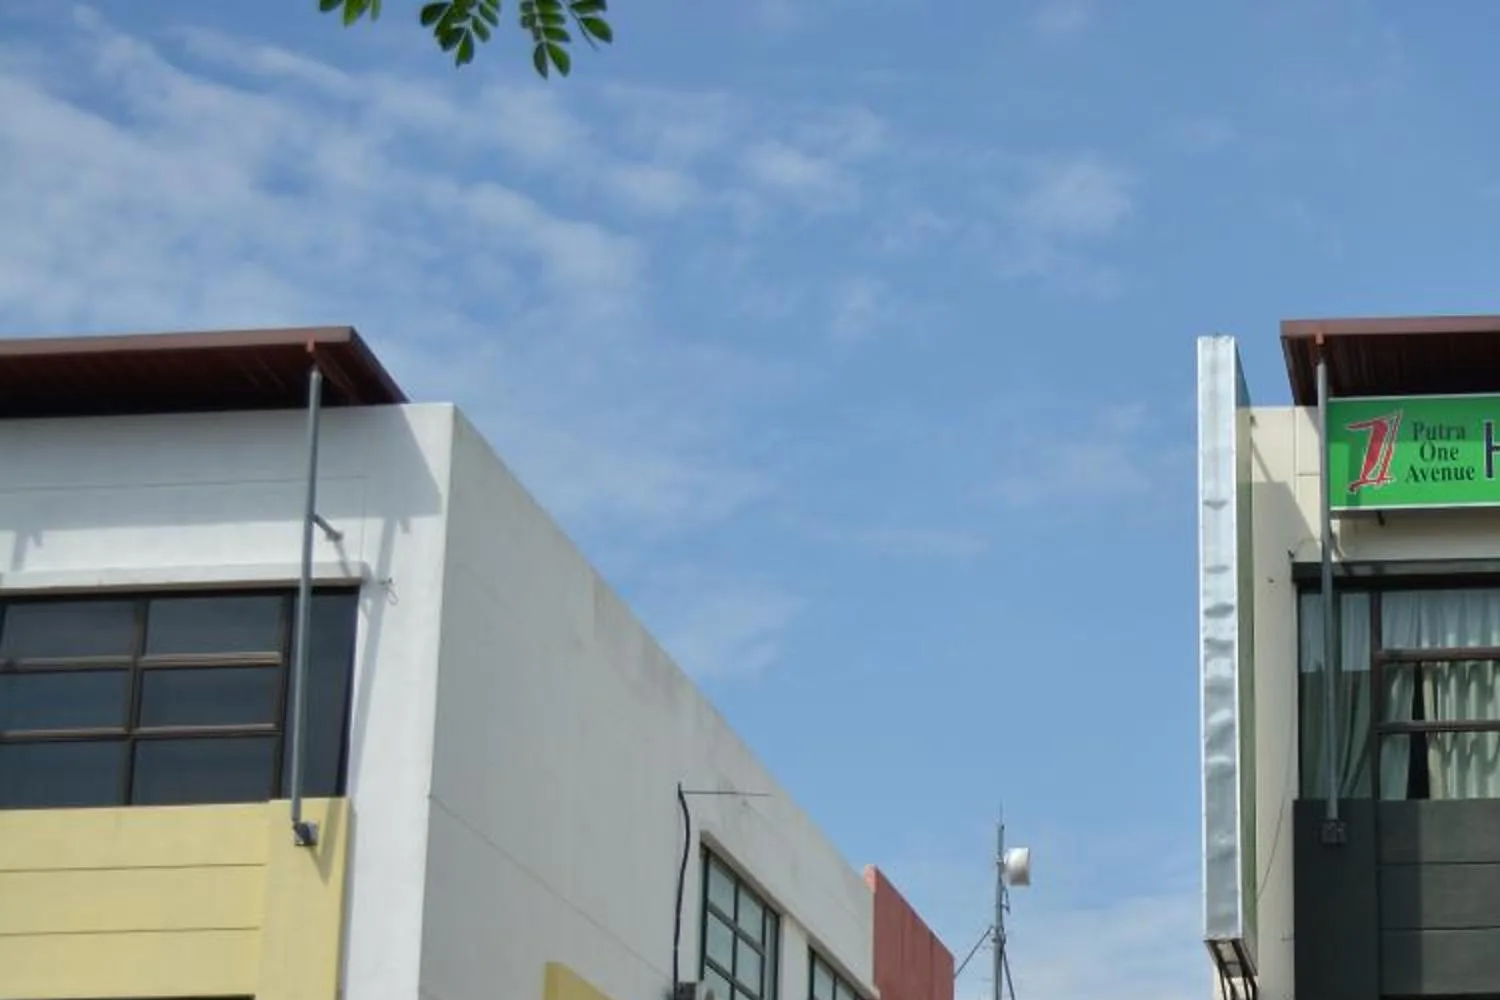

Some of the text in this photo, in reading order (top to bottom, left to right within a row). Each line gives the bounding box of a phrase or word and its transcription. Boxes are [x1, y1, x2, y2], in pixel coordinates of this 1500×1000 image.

[1412, 421, 1466, 441] Putra
[1419, 442, 1459, 461] One
[1405, 464, 1475, 483] Avenue
